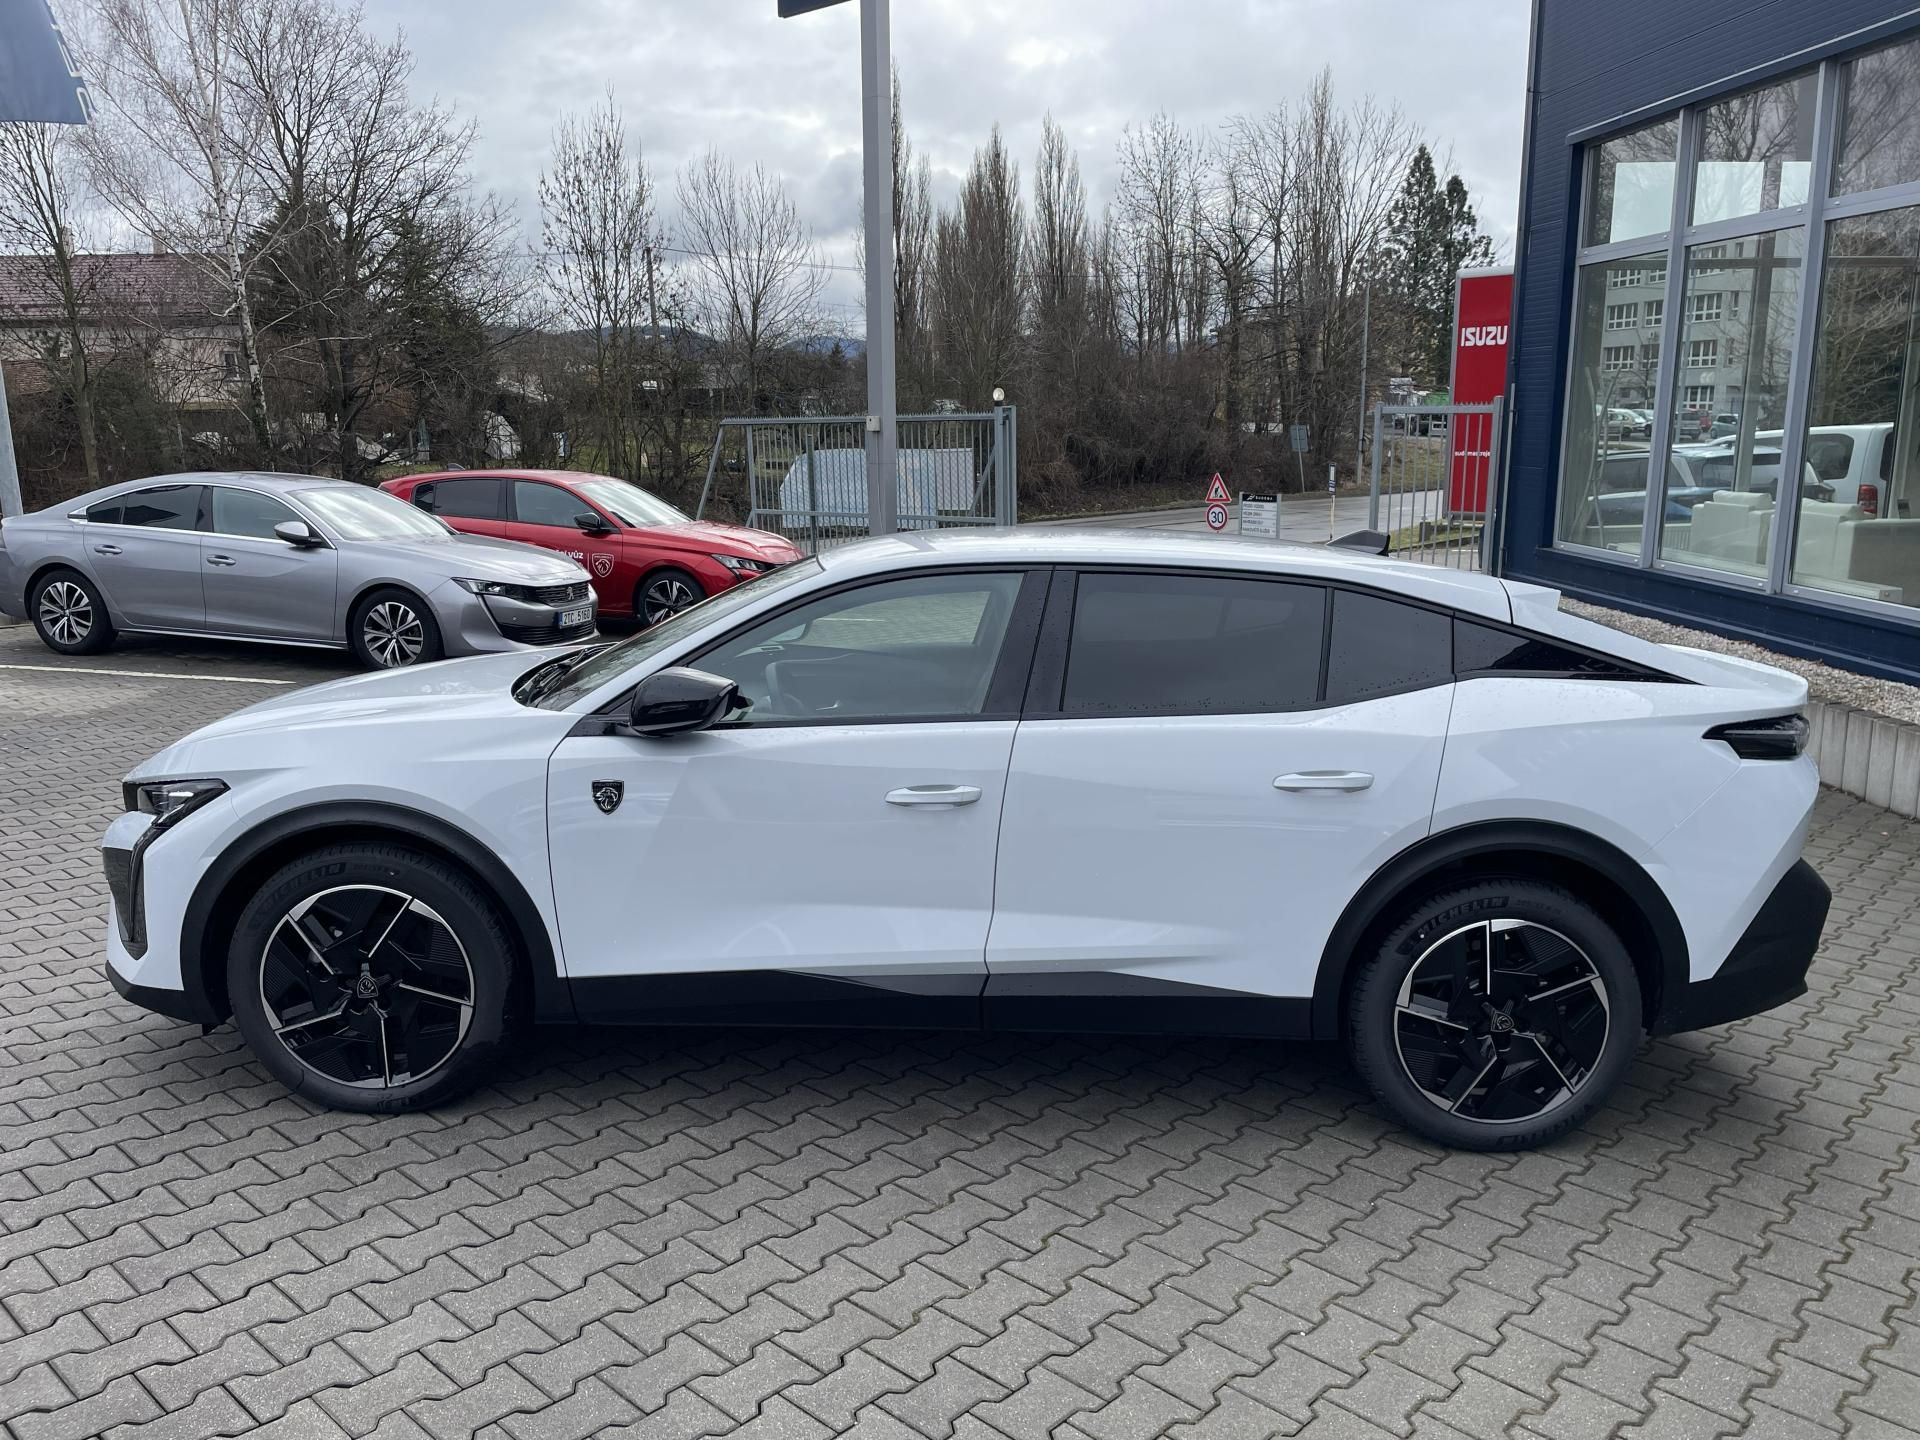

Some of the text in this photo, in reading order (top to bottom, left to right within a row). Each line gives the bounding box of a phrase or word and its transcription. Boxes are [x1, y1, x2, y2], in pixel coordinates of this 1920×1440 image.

[1461, 325, 1508, 347] ISUZU
[1211, 511, 1224, 524] 30
[564, 608, 591, 625] 2TC 5160
[1416, 896, 1507, 938] MICHELIN
